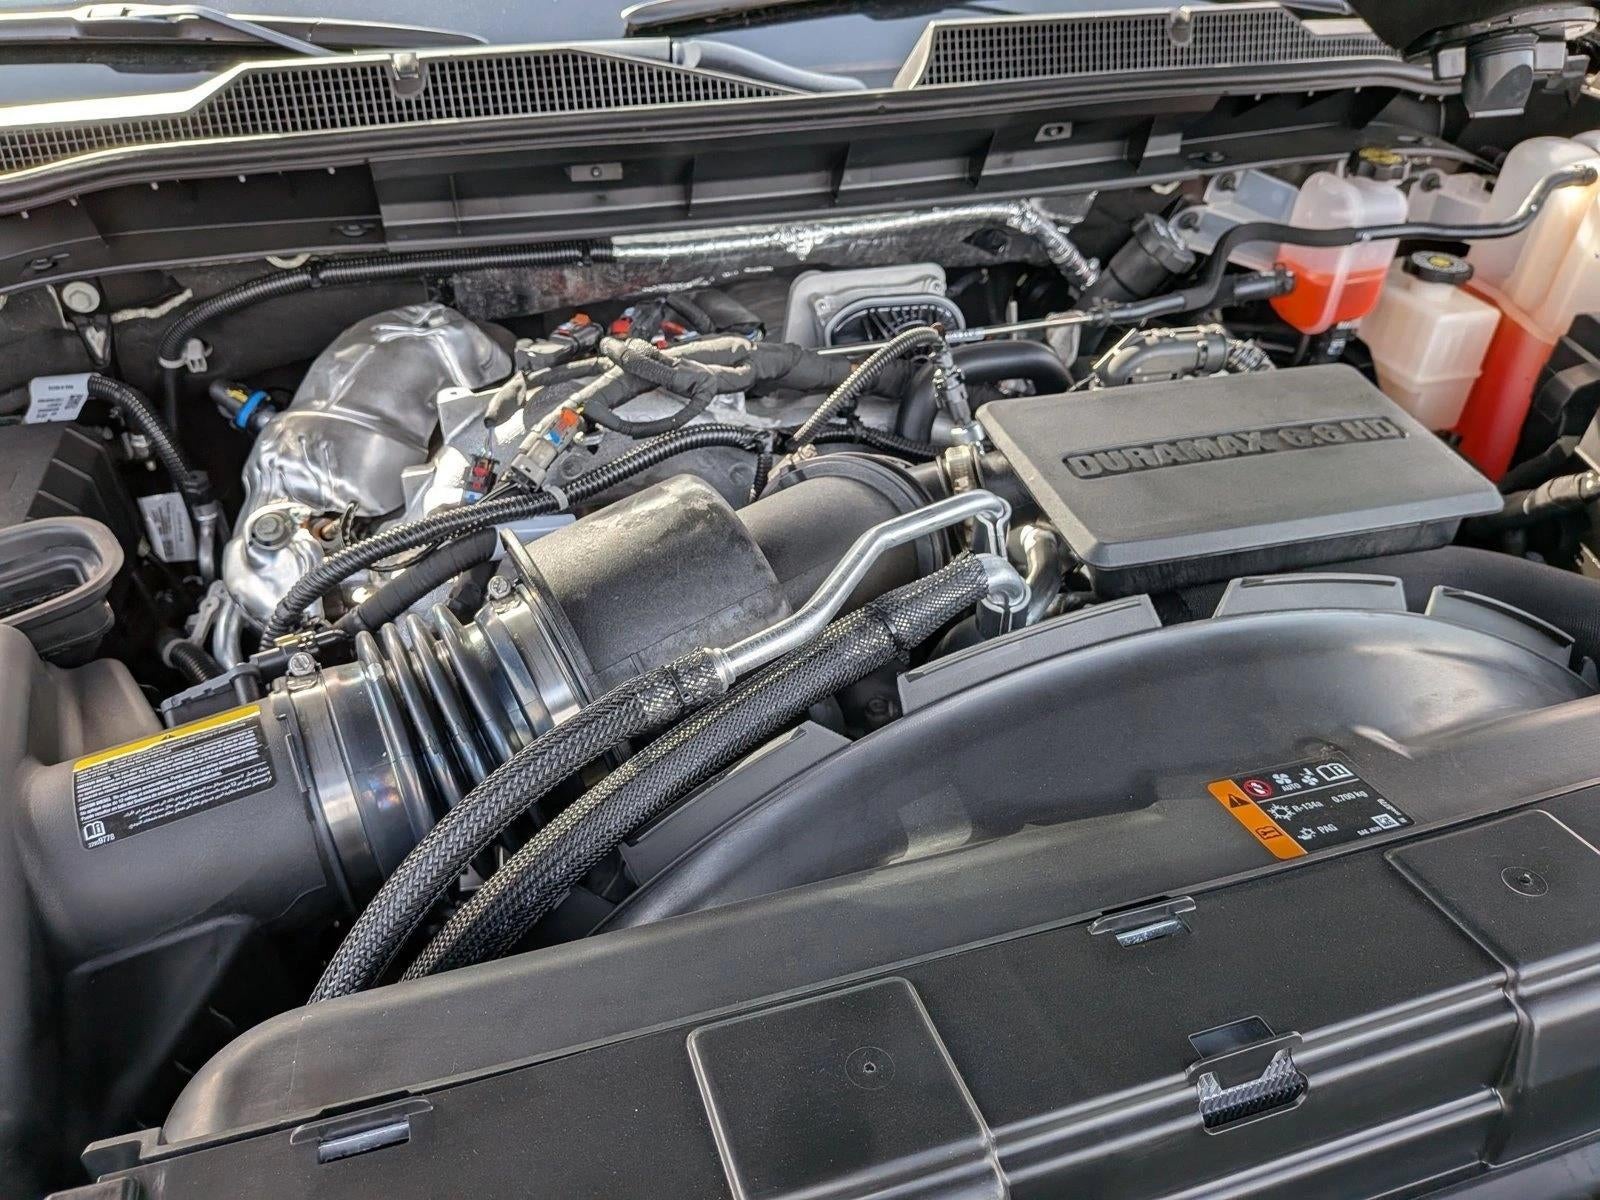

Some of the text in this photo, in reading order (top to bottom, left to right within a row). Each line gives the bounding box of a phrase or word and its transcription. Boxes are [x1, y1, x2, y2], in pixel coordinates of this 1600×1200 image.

[1066, 419, 1400, 477] DURAMAX 6.6 HD
[1281, 782, 1302, 791] AUTO
[1291, 790, 1369, 814] R-134a 0.700 kg
[1316, 823, 1338, 834] PAG
